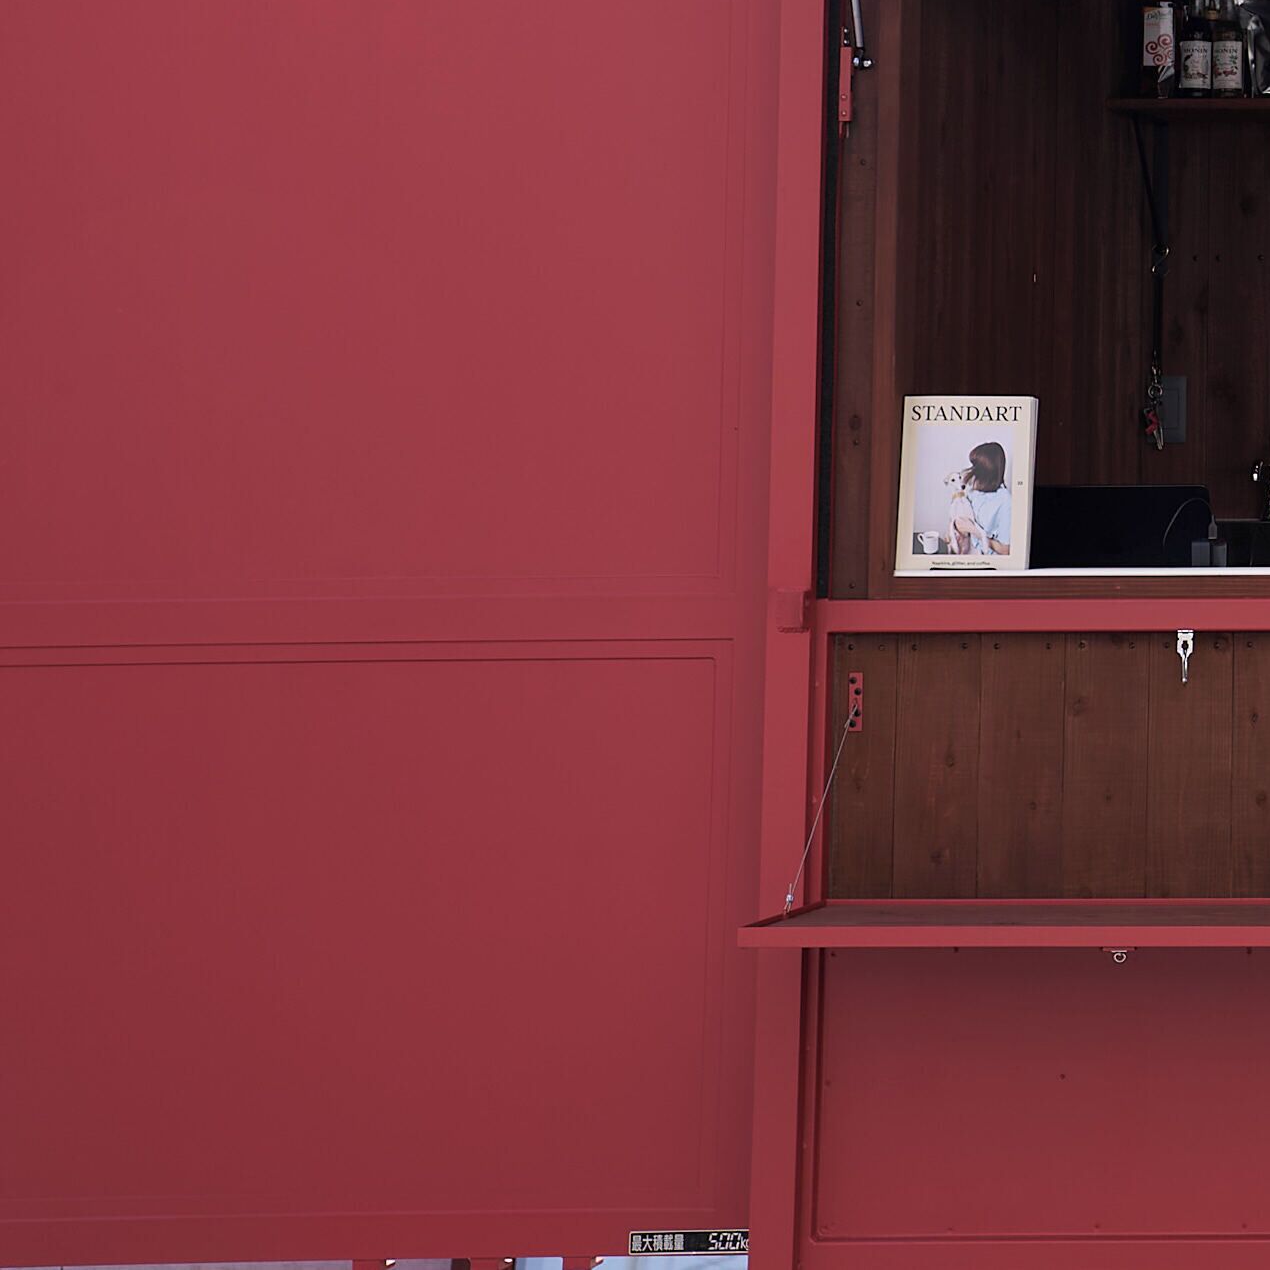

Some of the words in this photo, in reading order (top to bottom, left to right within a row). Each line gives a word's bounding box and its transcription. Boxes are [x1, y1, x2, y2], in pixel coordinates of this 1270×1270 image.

[911, 405, 1022, 422] STANDART
[631, 1234, 684, 1252] 最大積載量
